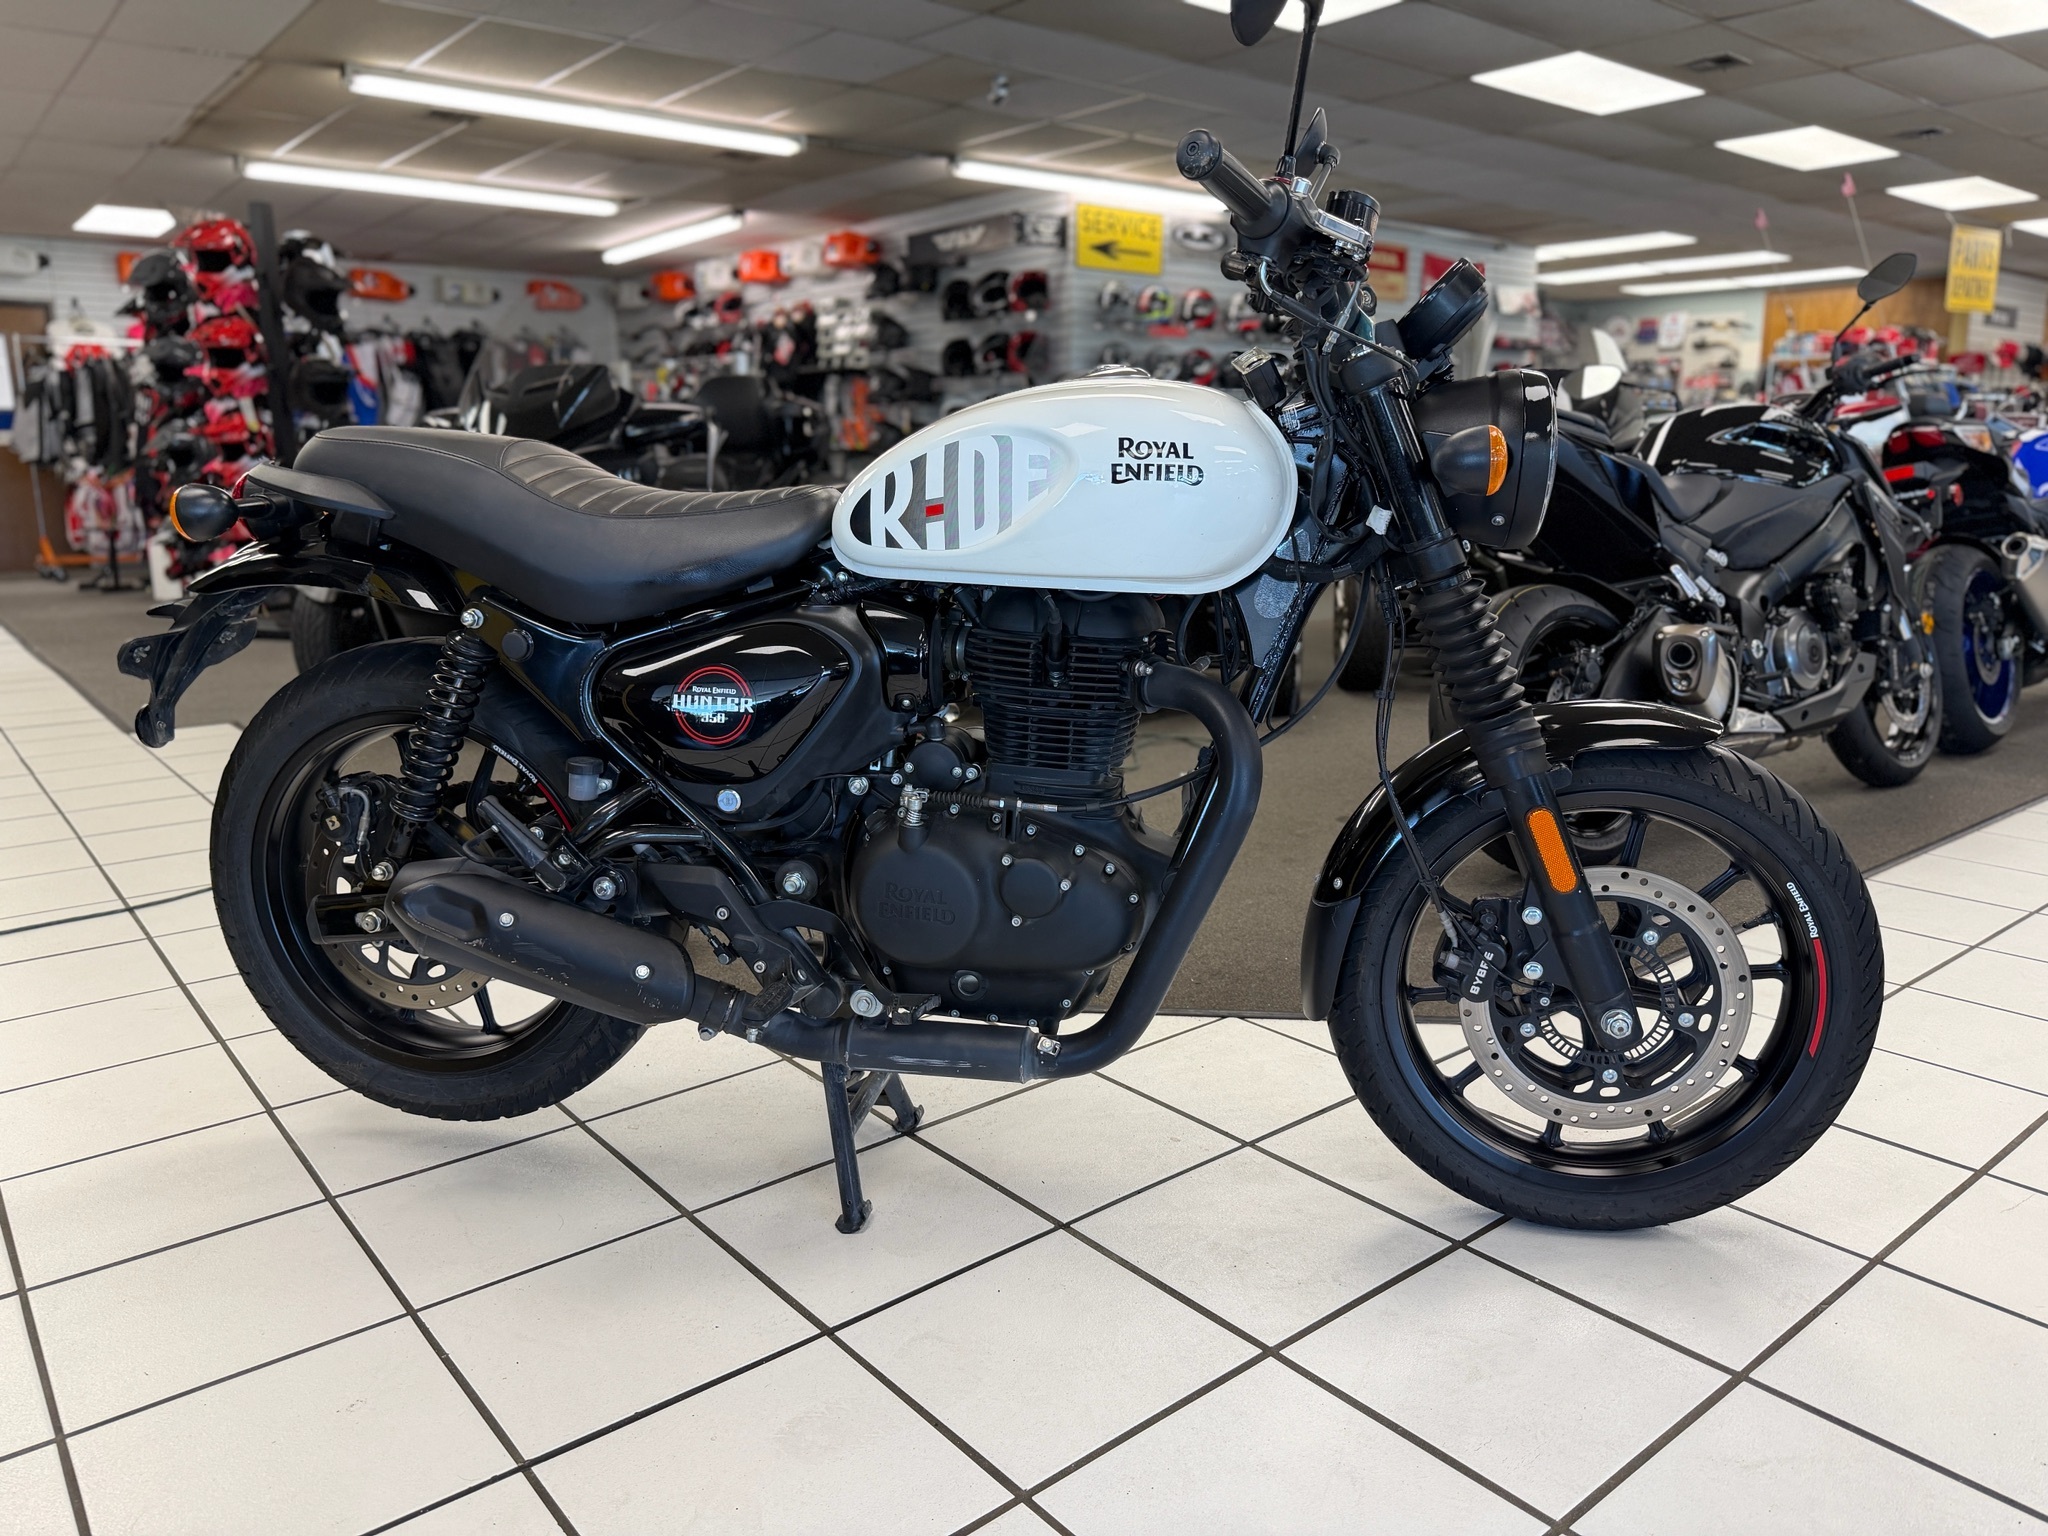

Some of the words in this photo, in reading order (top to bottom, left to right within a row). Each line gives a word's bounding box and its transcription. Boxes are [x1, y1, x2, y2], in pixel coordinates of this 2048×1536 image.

[1081, 207, 1158, 242] SERVICE
[1117, 436, 1194, 460] ROYAL
[1110, 462, 1205, 487] ENFIELD
[712, 686, 737, 695] ENFIELD
[673, 694, 755, 713] HUNTER
[883, 882, 948, 905] ROYAL
[1786, 881, 1809, 912] ENFIELD
[878, 901, 956, 926] ENFIELD
[1803, 911, 1819, 938] ROYAL
